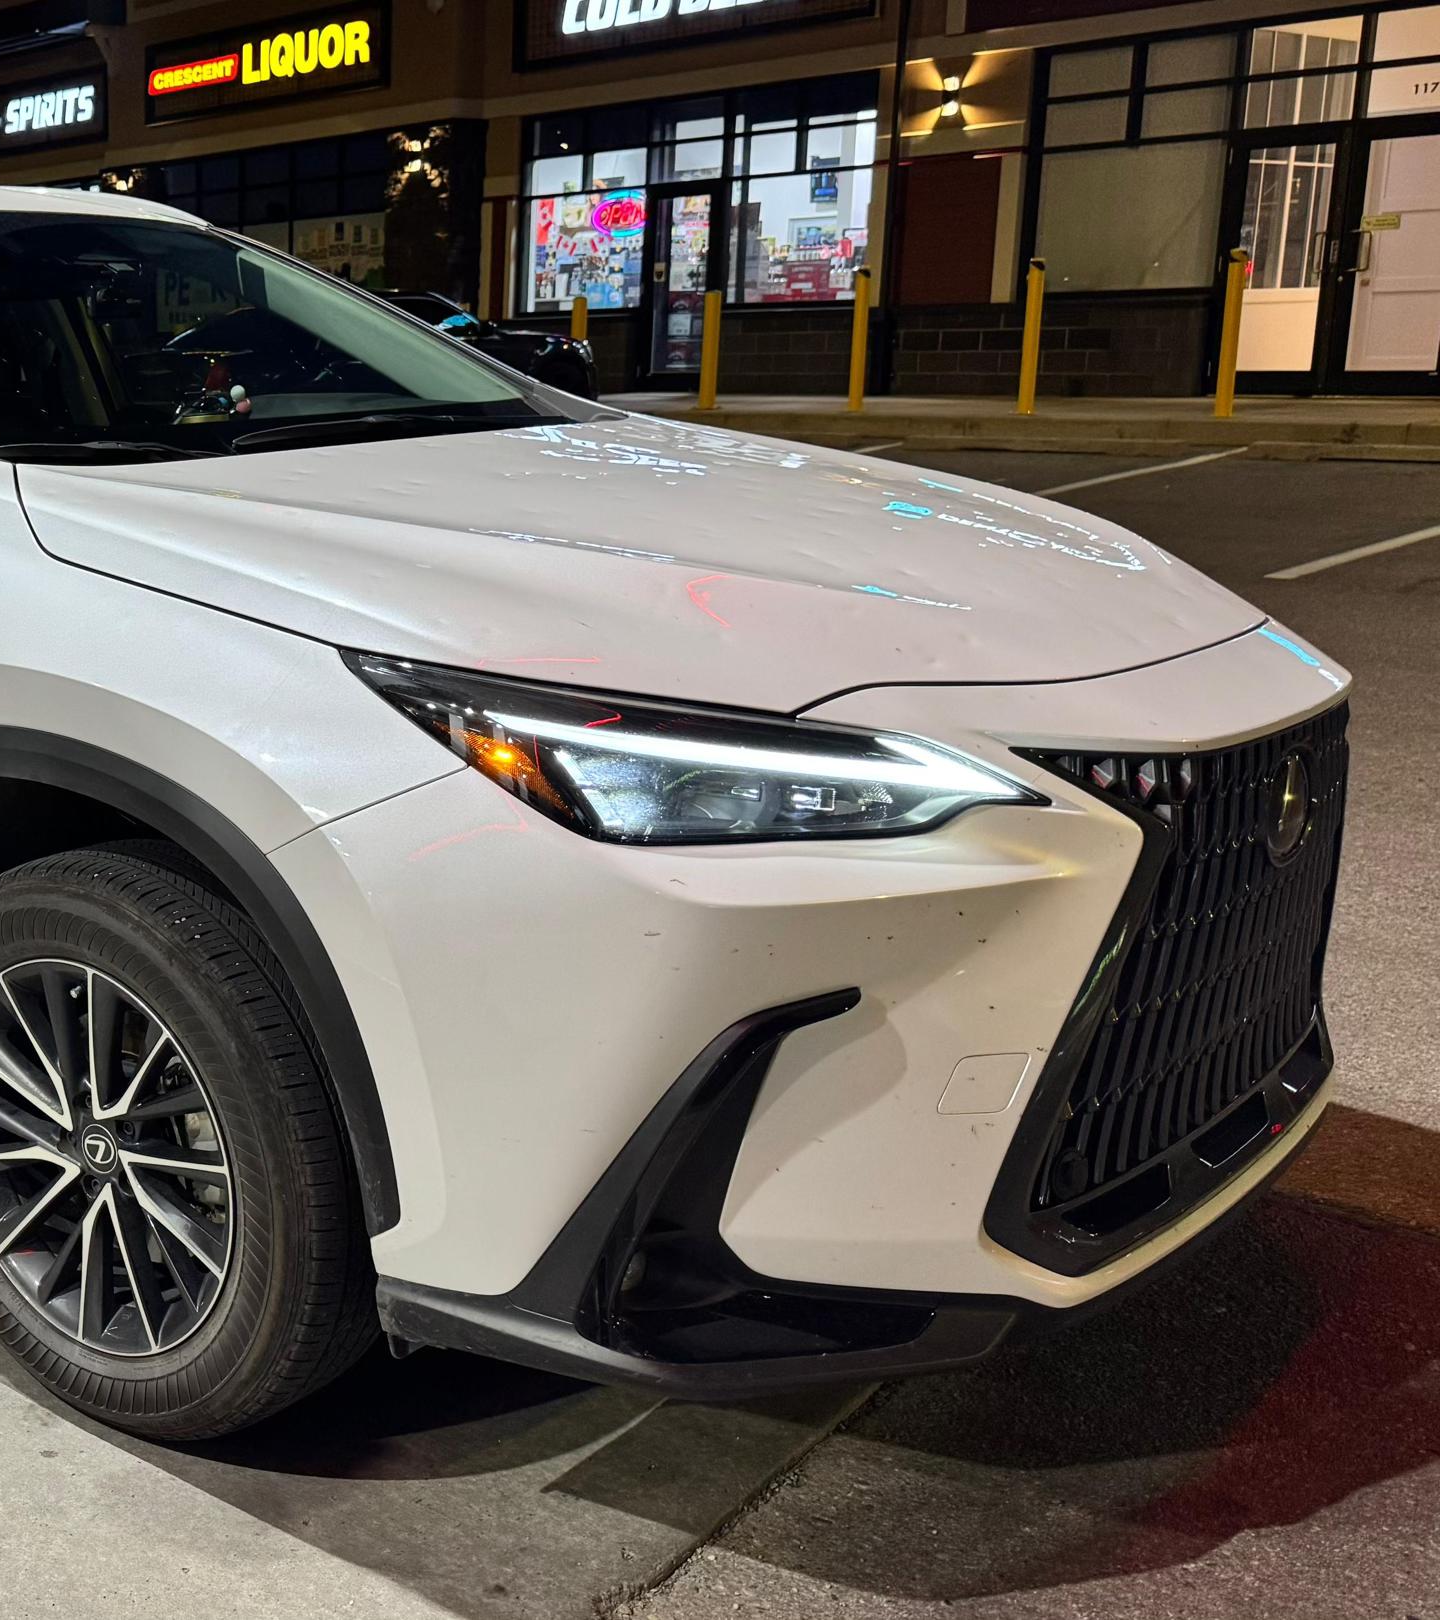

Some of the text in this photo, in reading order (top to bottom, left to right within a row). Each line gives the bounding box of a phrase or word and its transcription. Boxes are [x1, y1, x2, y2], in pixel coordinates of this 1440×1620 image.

[152, 20, 371, 90] CRESCENT LIQUOR
[4, 84, 95, 134] SPIRITS
[600, 201, 647, 227] OPEN
